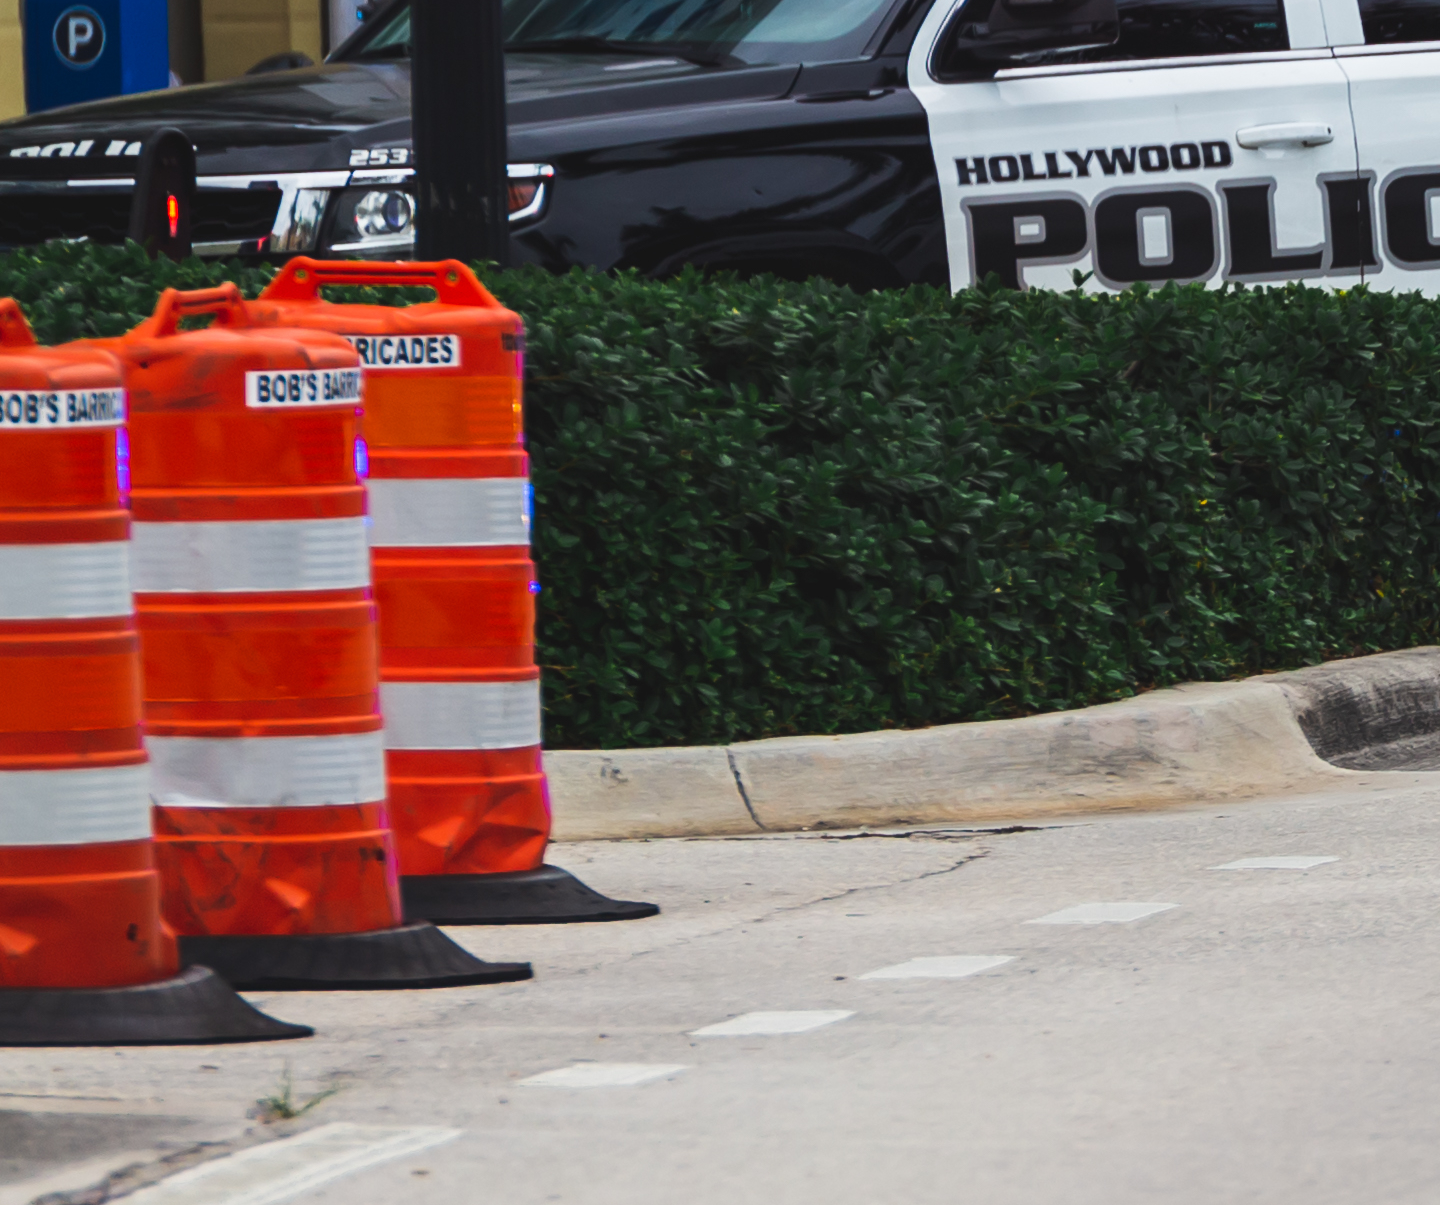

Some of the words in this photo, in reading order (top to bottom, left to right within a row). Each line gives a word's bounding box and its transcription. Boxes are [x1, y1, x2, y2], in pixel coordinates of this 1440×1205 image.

[349, 148, 414, 166] 253
[953, 139, 1234, 186] HOLLYWOOD
[349, 335, 453, 365] RICADES
[257, 372, 318, 403] BOB'S
